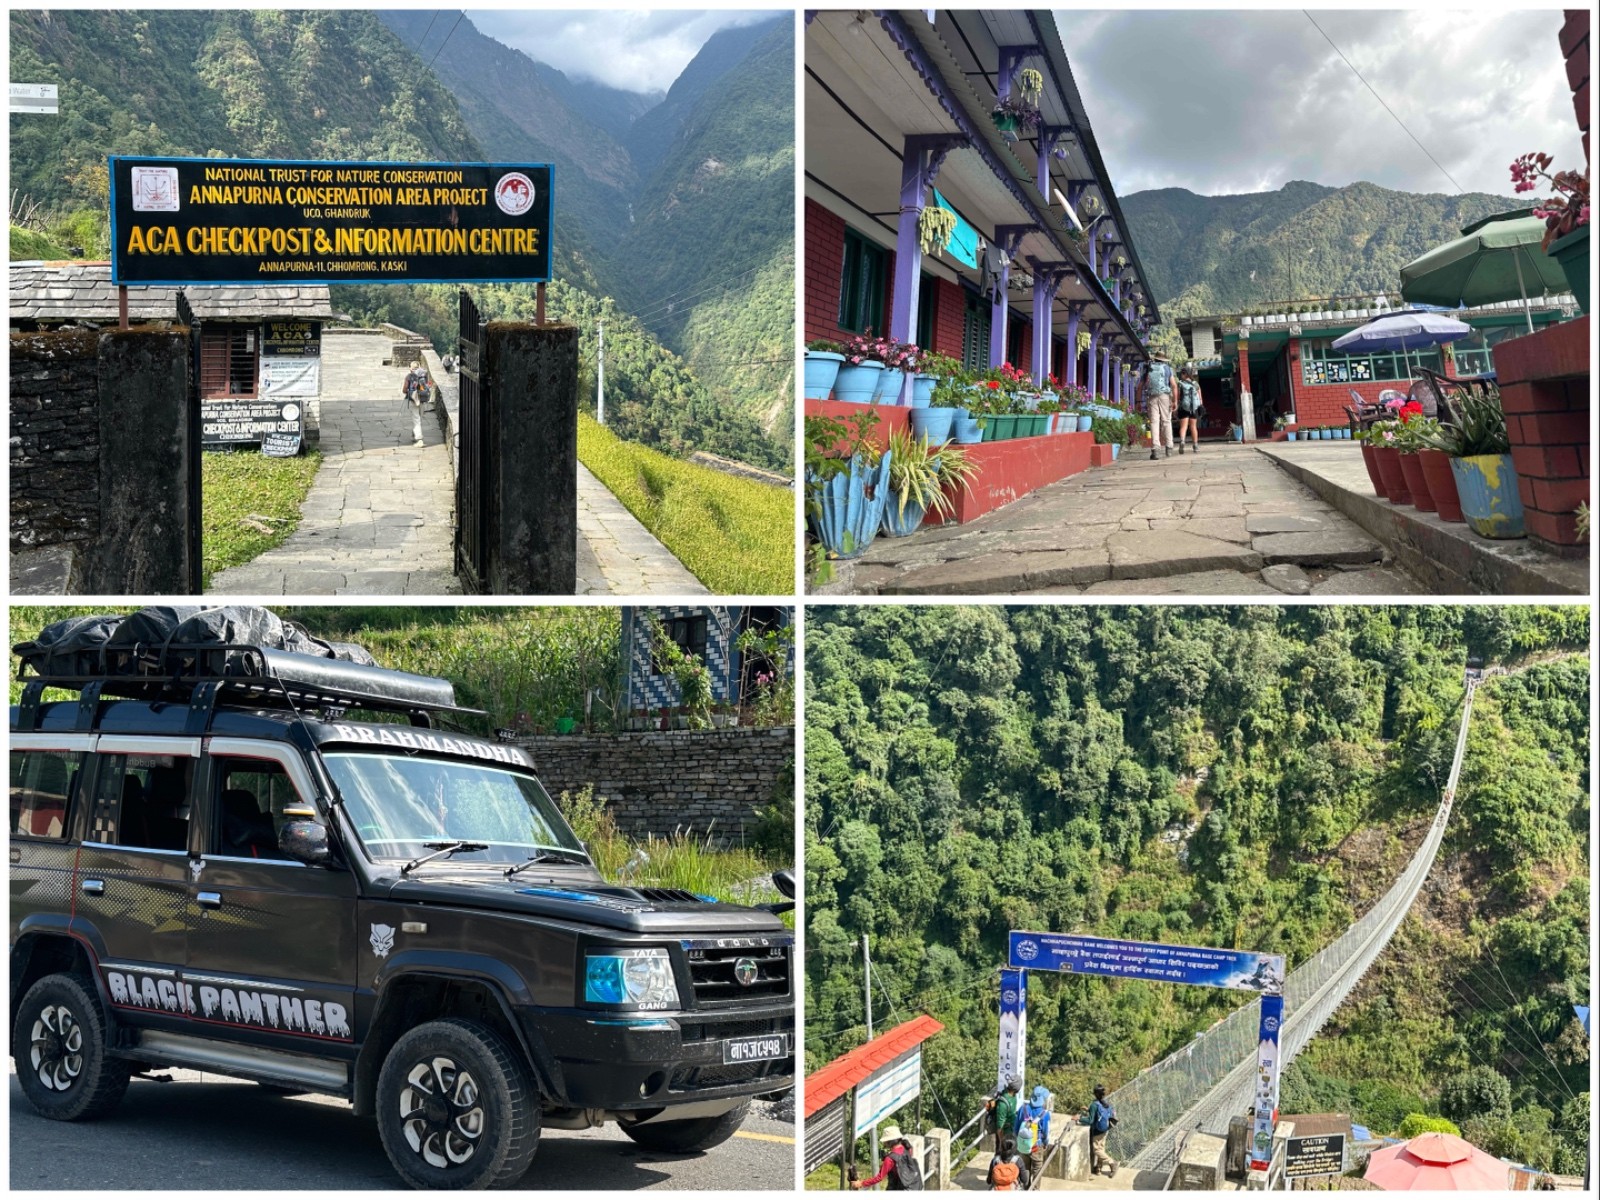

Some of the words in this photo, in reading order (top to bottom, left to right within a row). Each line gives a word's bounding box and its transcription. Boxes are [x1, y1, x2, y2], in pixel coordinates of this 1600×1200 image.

[205, 167, 266, 182] NATIONAL
[269, 169, 307, 182] TRUST
[310, 170, 333, 183] FOR
[337, 170, 380, 184] NATURE
[383, 170, 462, 184] CONSERVATION
[189, 185, 283, 205] ANNAPURNA
[286, 186, 394, 206] CONSERVATION
[395, 188, 432, 206] AREA
[434, 188, 488, 206] PROJECT
[324, 208, 371, 219] GHANDRUK
[127, 226, 183, 256] ACA
[186, 226, 312, 256] CHECKPOST
[335, 228, 468, 256] INFORMATION
[469, 228, 540, 256] CENTRE
[381, 260, 407, 272] KASKI
[277, 421, 299, 431] CENTER
[333, 724, 527, 766] BRAHMANDHA
[632, 949, 658, 957] TATA
[1176, 950, 1201, 958] ANNAPURNA
[108, 972, 197, 1014] BLACK
[199, 986, 351, 1038] PANTHER
[638, 1001, 668, 1010] GANG
[1301, 1138, 1329, 1146] CAUTION
